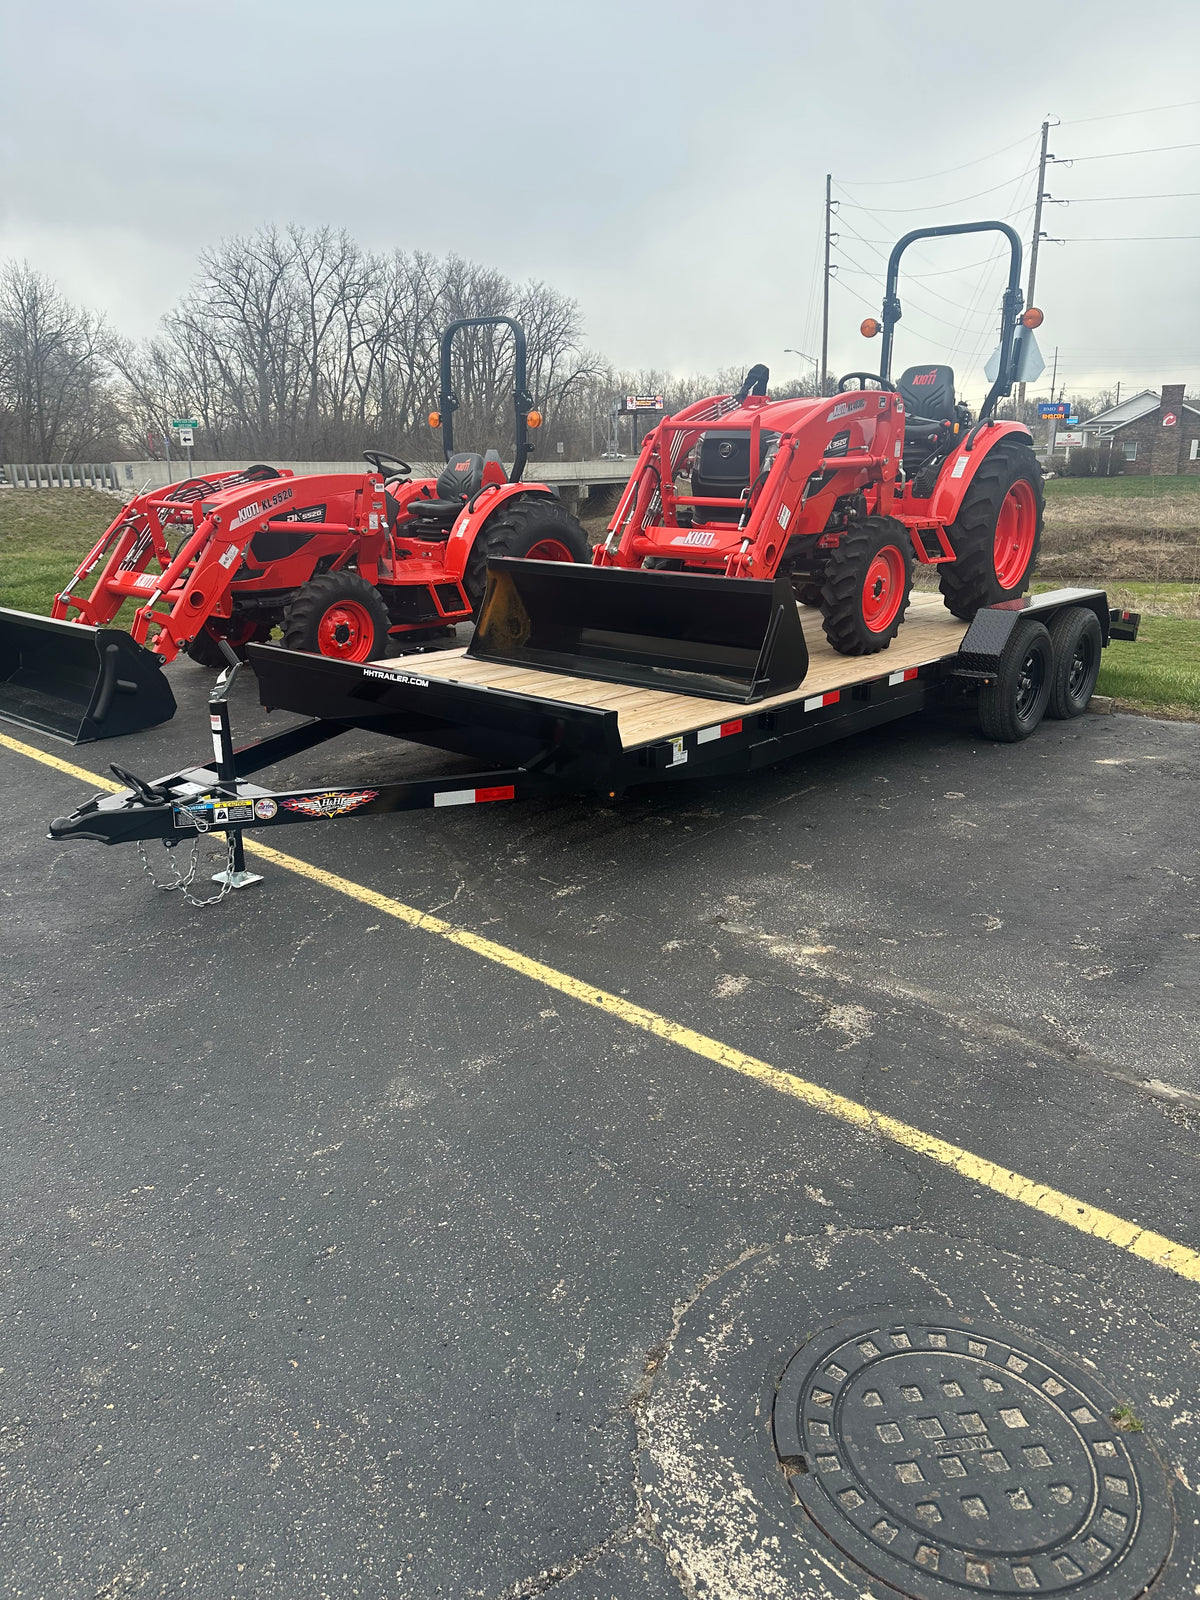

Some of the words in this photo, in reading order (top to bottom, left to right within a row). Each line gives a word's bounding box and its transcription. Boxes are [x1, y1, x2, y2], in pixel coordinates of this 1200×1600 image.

[912, 372, 937, 385] KIOTI
[237, 502, 260, 522] KIOTI
[684, 531, 715, 545] KIOTI
[363, 669, 429, 687] HHTRAILER.COM
